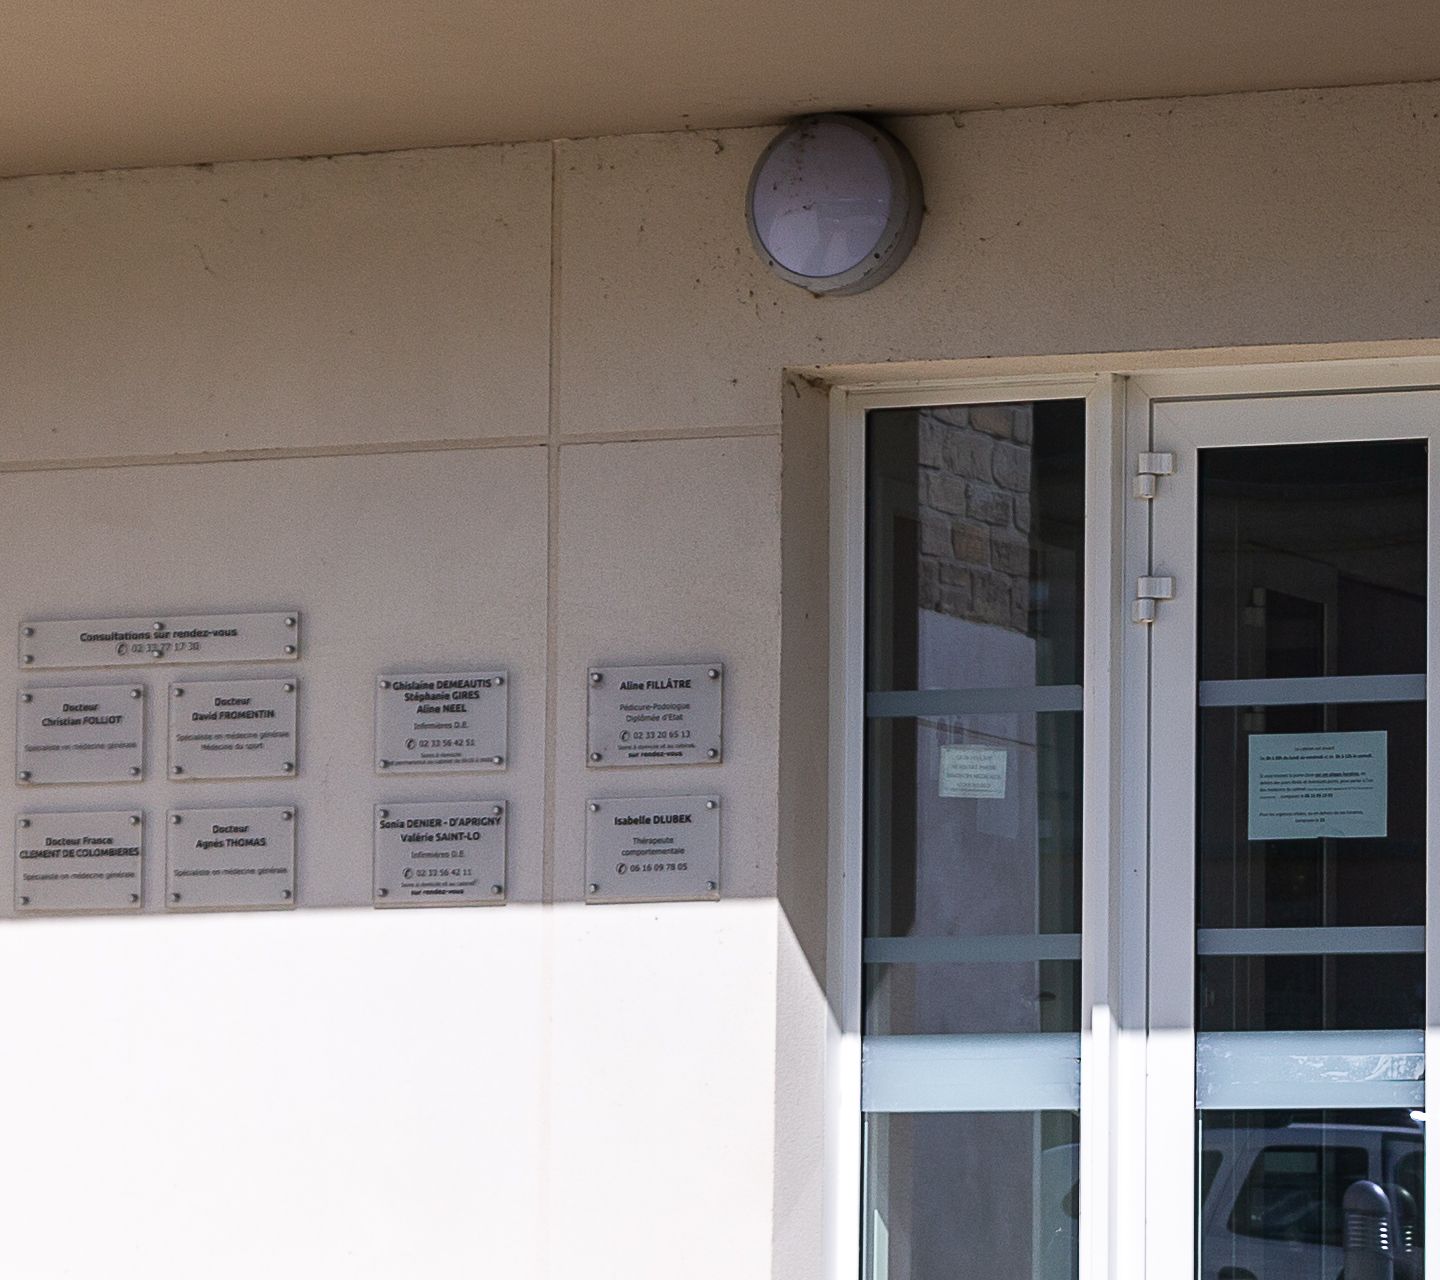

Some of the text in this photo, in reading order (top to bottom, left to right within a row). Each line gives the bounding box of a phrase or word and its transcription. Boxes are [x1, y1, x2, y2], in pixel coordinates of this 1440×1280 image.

[80, 628, 237, 642] Consultations sur rendez-vous
[132, 644, 143, 652] 02
[392, 679, 492, 690] Ghislaine DEMEAUTIS
[620, 677, 691, 690] Aline FILLÂTRE
[404, 690, 480, 702] Stéphanie GIRES
[215, 698, 250, 706] Docteur
[63, 704, 98, 712] Docteur
[417, 704, 467, 713] Aline NEEL
[192, 710, 274, 720] David FROMENTIN
[42, 715, 123, 726] Christian FOLLIOT
[380, 819, 404, 829] Sonia
[407, 818, 442, 828] DENIER
[449, 817, 501, 827] D'APRIGNY
[614, 814, 692, 825] Isabelle DLUBEK
[212, 825, 249, 834] Docteur
[46, 837, 80, 846] Docteur
[401, 832, 434, 842] Valérie
[196, 838, 266, 849] Agnès THOMAS
[62, 849, 74, 857] DE
